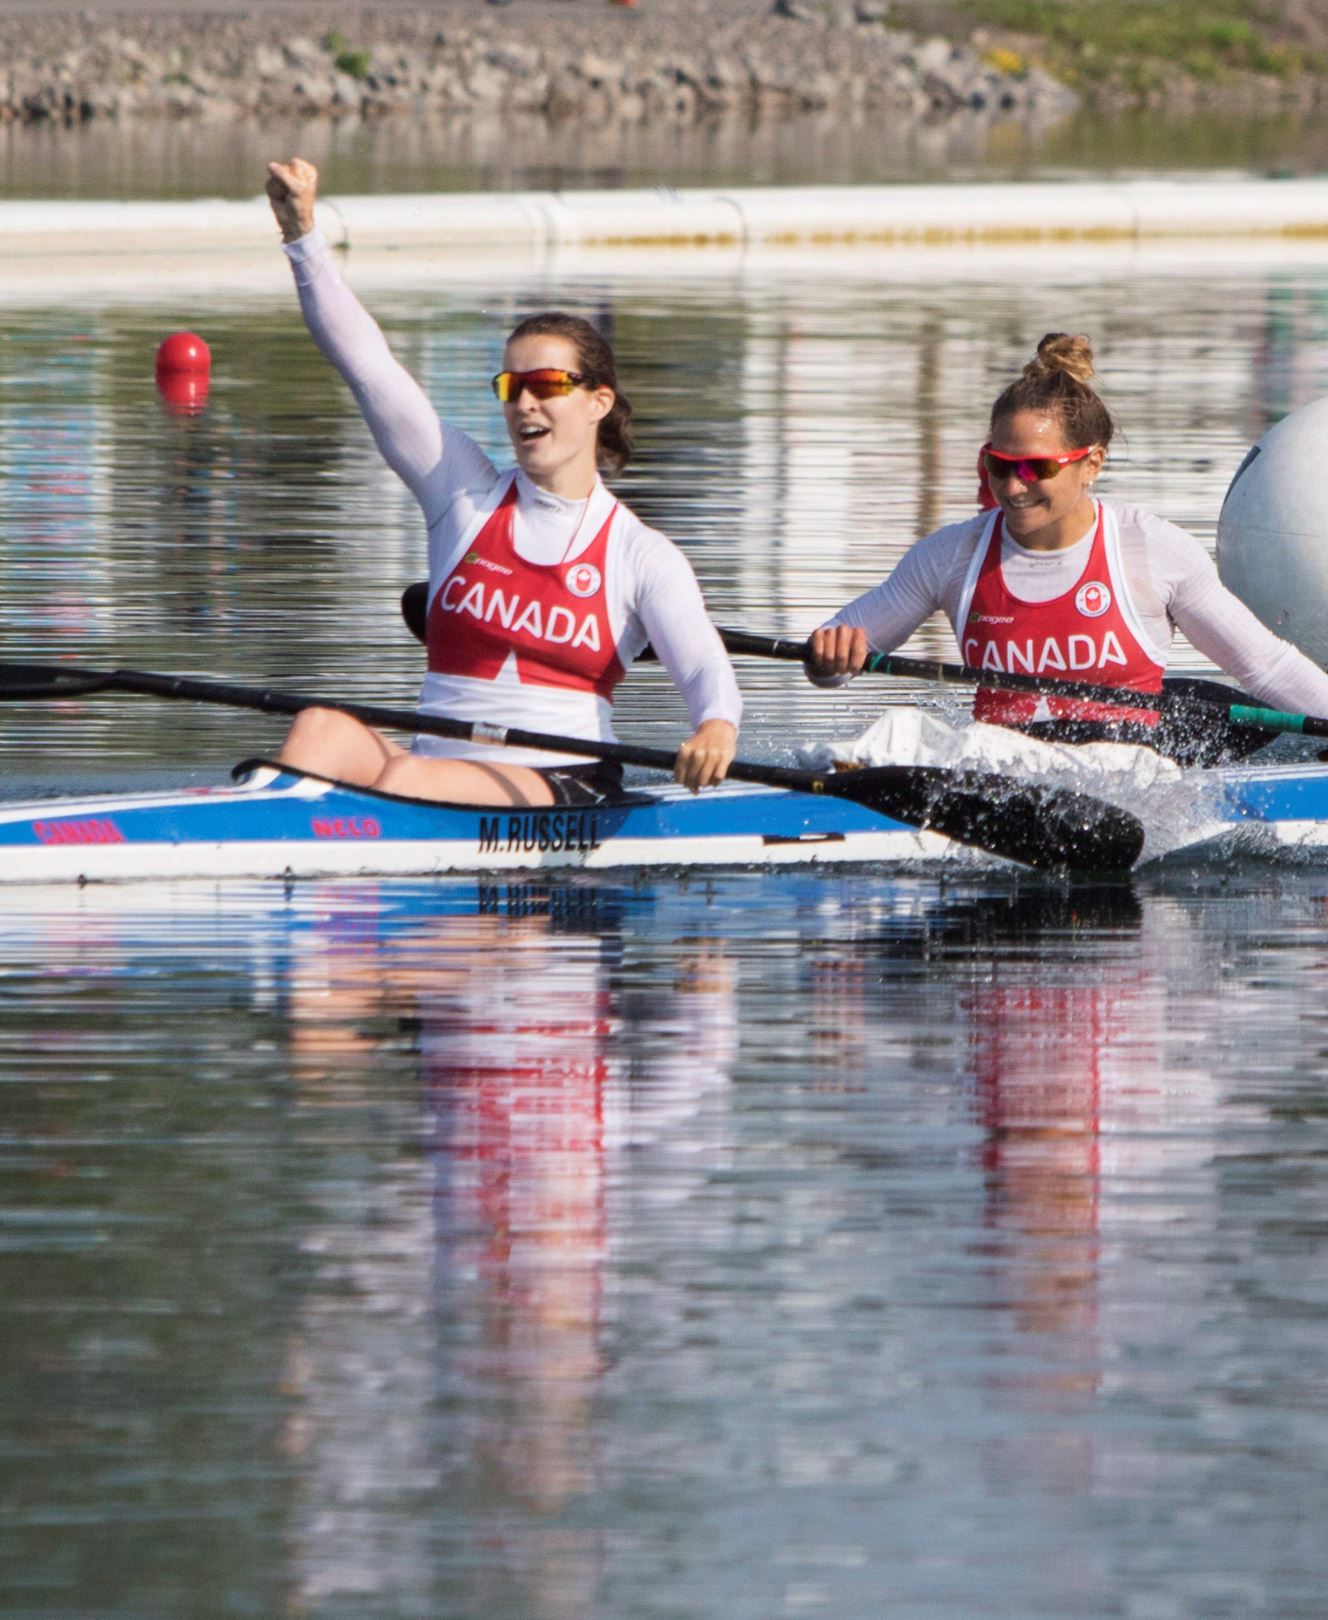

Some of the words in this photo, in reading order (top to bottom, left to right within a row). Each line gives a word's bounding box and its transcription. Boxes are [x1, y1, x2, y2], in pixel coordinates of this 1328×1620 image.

[441, 576, 601, 652] CANADA
[965, 631, 1128, 674] CANADA
[312, 819, 381, 838] NELO
[478, 814, 600, 854] M.RUSSELL
